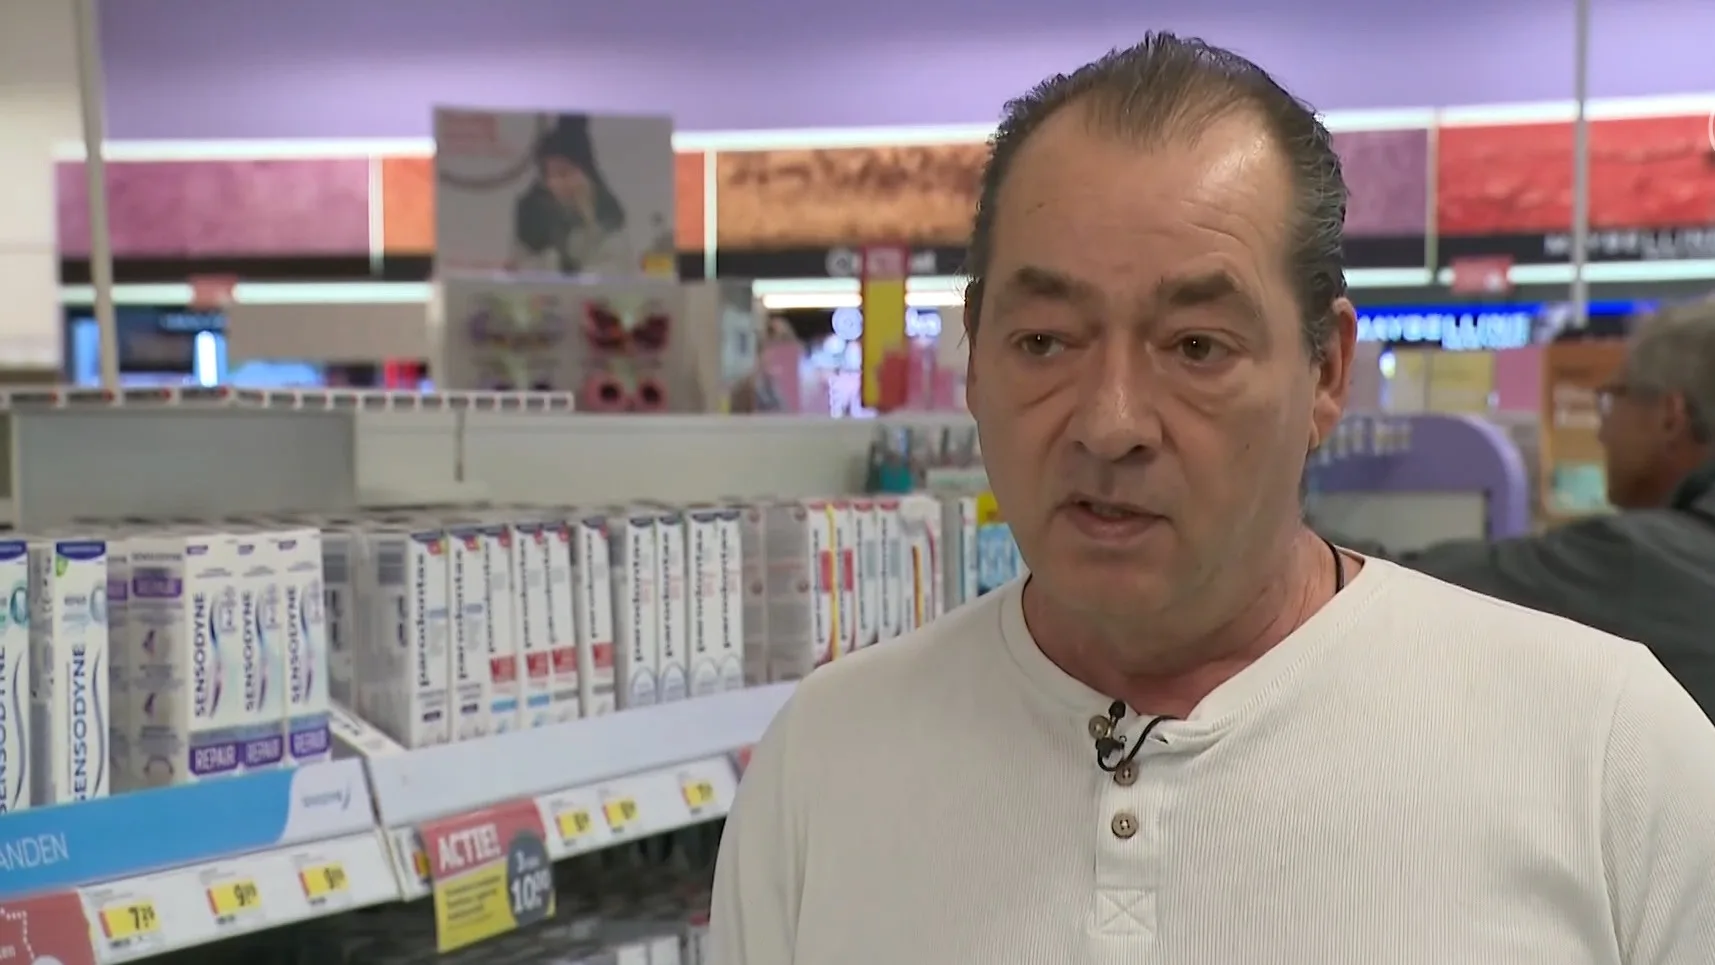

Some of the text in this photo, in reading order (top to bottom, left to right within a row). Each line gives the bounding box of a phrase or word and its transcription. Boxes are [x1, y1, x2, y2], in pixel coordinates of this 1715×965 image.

[287, 586, 300, 704] SENSODYNE
[416, 552, 430, 687] parodontax
[454, 549, 468, 680] parodontax
[633, 533, 644, 663] parodontax
[662, 530, 673, 658] parodontax
[695, 529, 706, 653] parodontax
[720, 527, 731, 649] parodontax
[193, 592, 206, 718] SENSODYNE
[242, 591, 254, 712] SENSODYNE
[194, 743, 236, 772] REPAIR
[245, 736, 283, 767] REPAIR
[437, 822, 502, 873] ACTIE!
